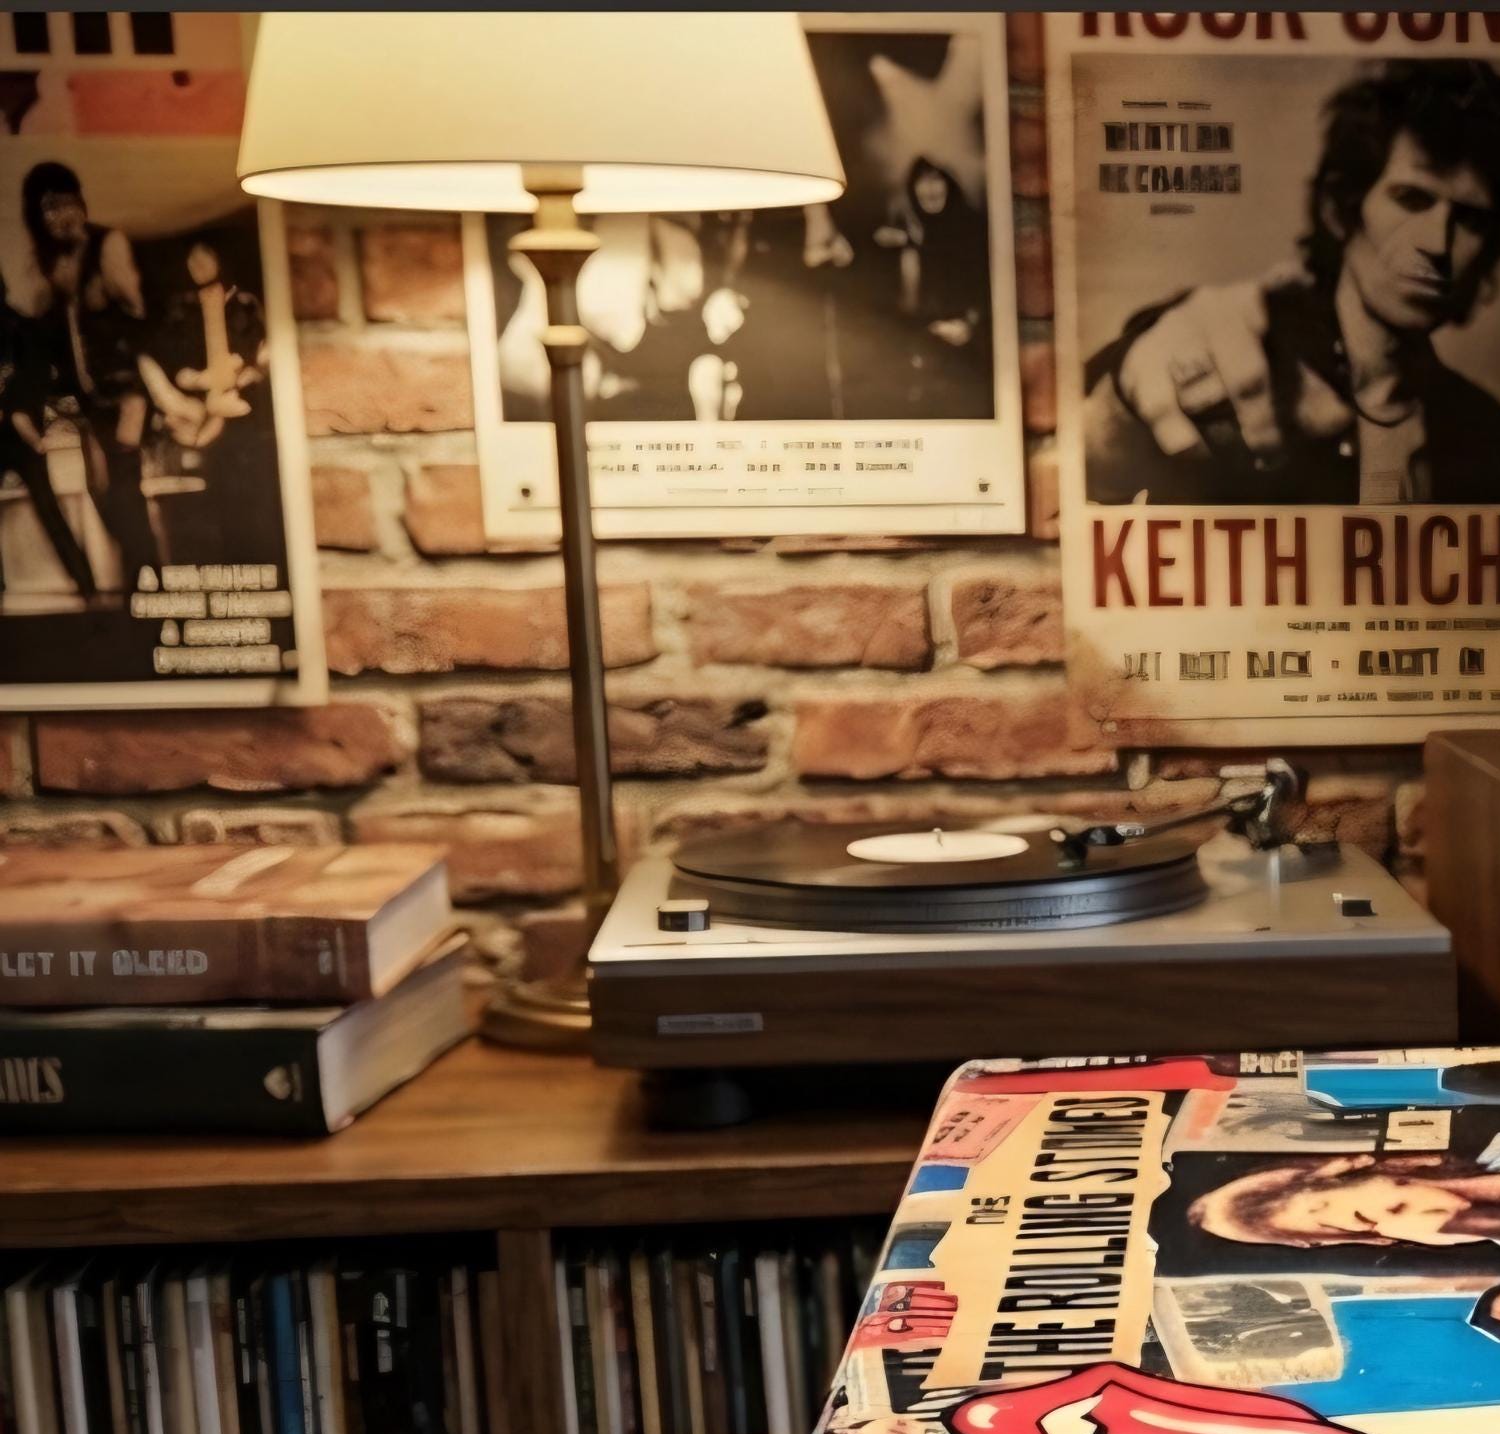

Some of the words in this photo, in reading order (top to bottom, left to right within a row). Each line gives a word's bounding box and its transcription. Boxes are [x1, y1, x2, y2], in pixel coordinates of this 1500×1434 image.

[1092, 516, 1308, 609] KEITH
[996, 1192, 1135, 1313] ROLLING
[979, 1319, 1117, 1381] THE
